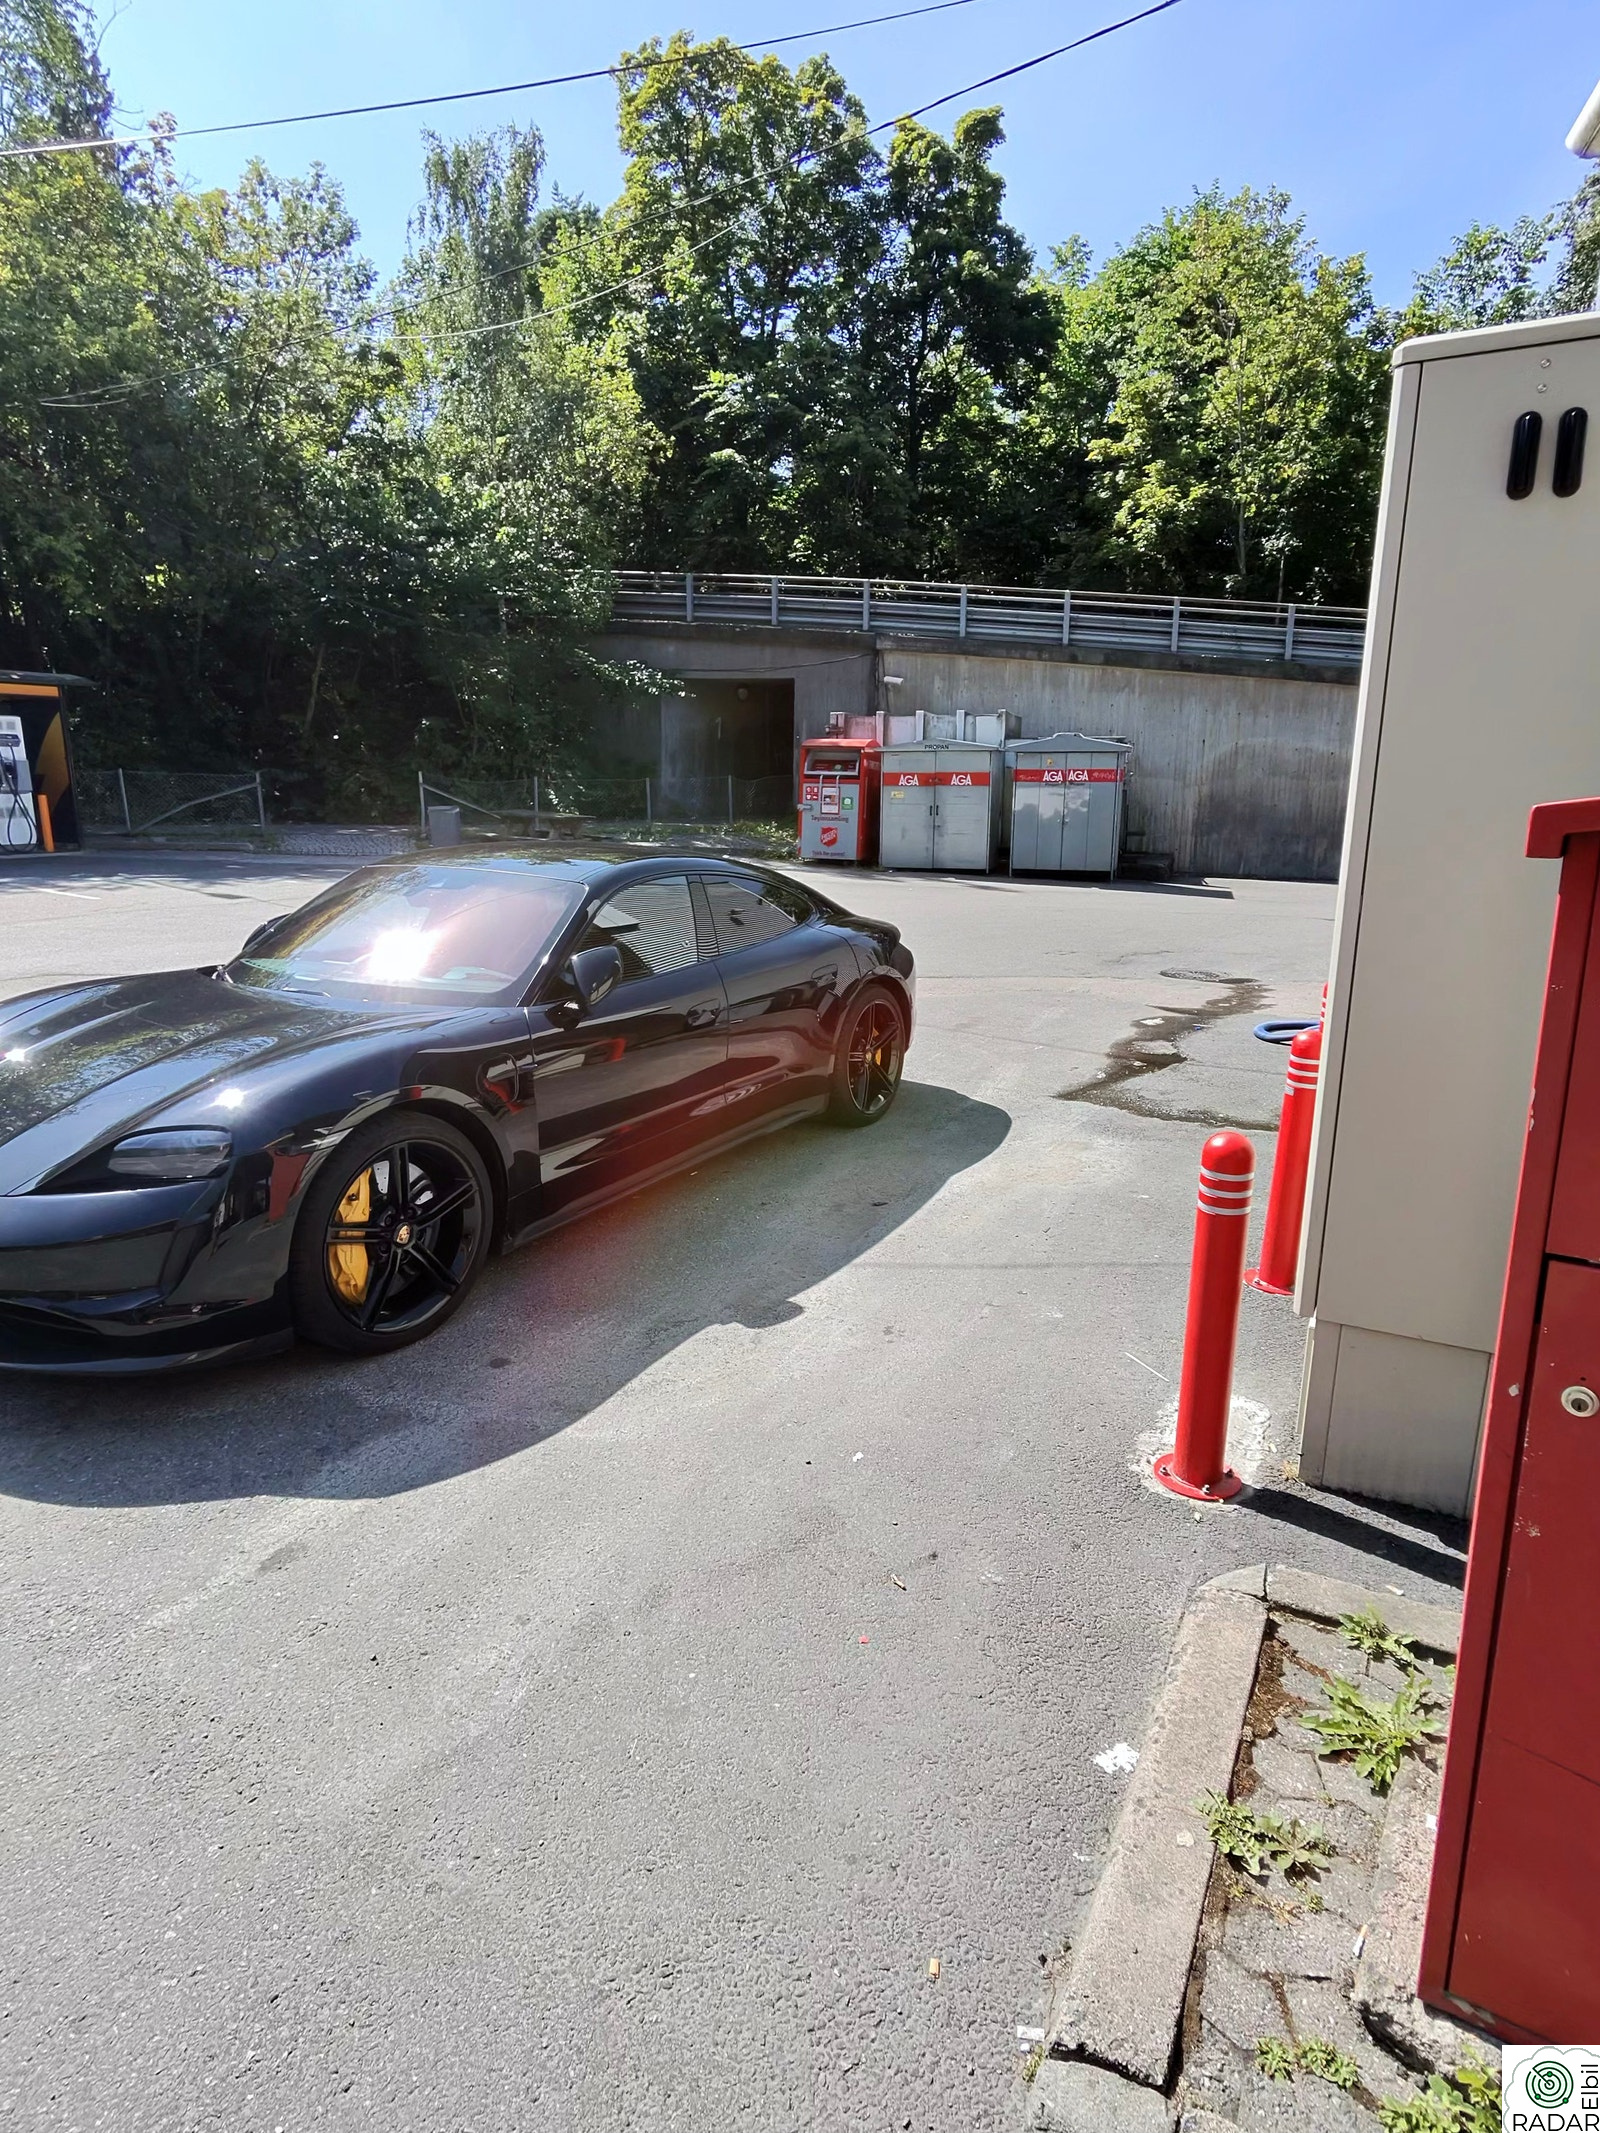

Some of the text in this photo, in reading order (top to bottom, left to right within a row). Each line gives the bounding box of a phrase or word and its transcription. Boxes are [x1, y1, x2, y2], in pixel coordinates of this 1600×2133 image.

[898, 773, 919, 786] AGA
[951, 773, 972, 786] AGA
[1043, 770, 1063, 782] AGA
[1069, 769, 1089, 781] AGA
